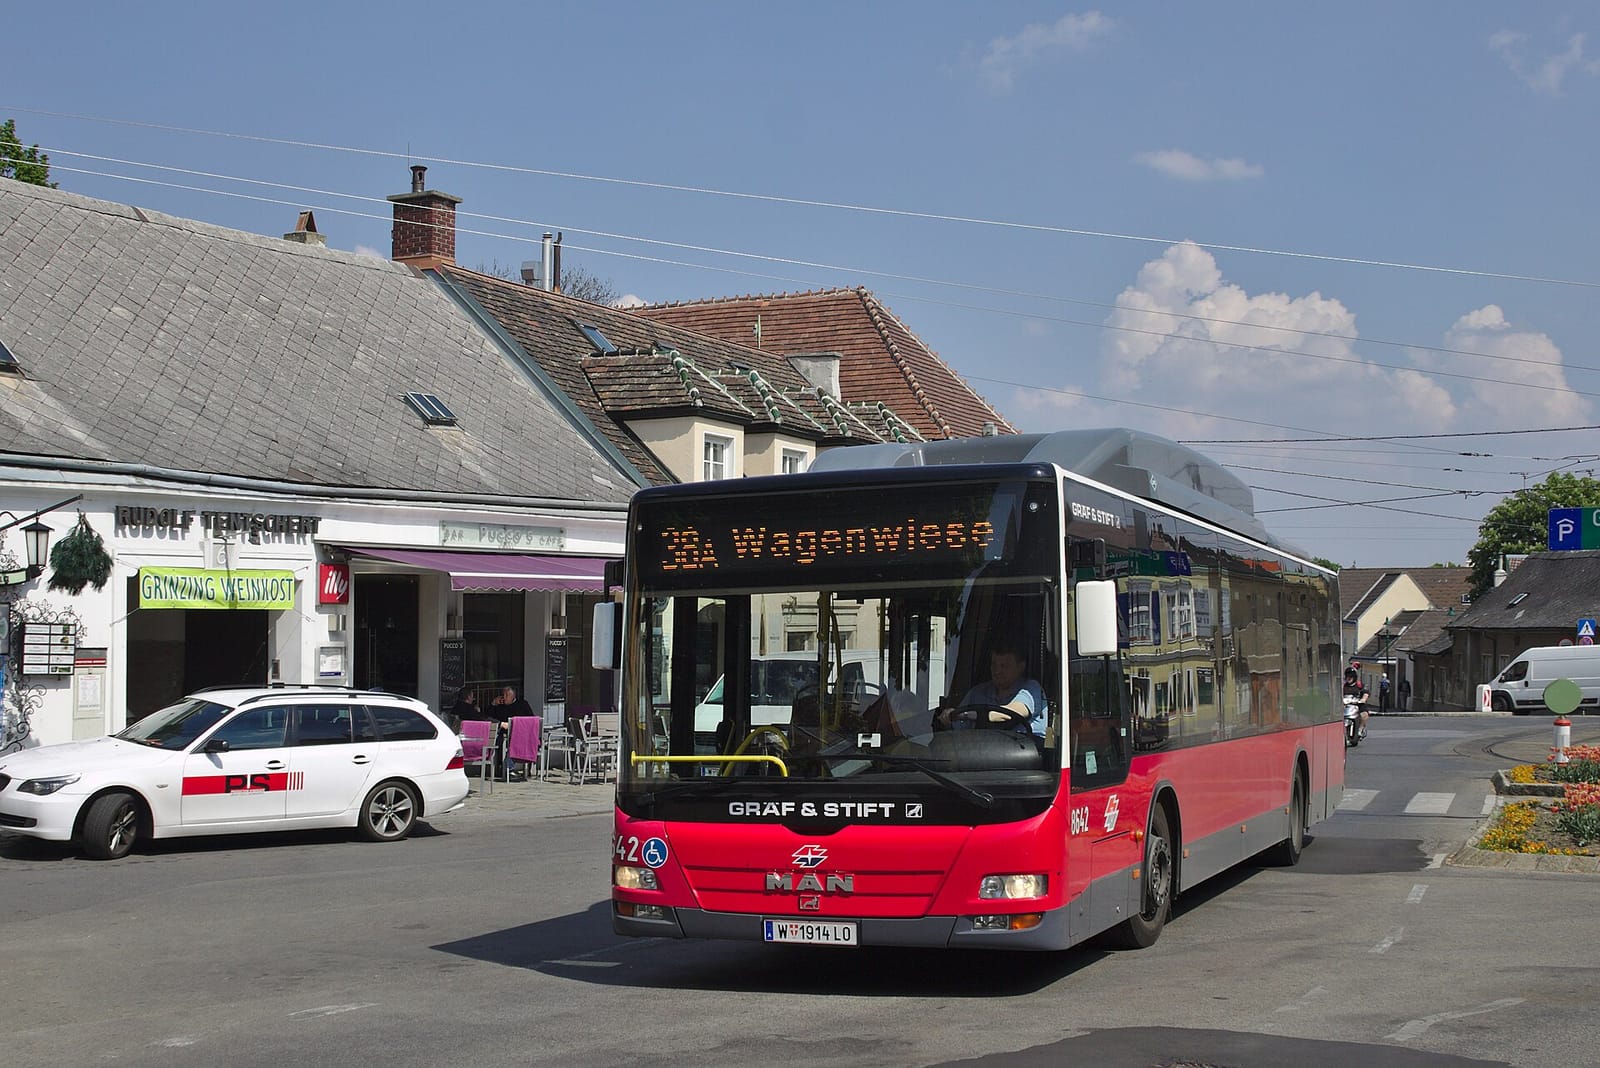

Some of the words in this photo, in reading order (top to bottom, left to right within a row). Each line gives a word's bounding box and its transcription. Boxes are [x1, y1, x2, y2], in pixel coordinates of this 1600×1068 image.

[115, 506, 196, 530] RUDOLF
[1097, 510, 1114, 526] STIFT
[732, 518, 994, 564] Wagenwiese
[141, 575, 215, 600] GRINZING
[221, 577, 293, 601] WEINKOST
[324, 571, 348, 600] illy
[729, 801, 795, 817] GRÄF
[800, 802, 818, 817] &
[824, 802, 895, 818] STIFT
[1071, 806, 1089, 835] 8642
[766, 873, 854, 892] MAN
[778, 924, 789, 938] W
